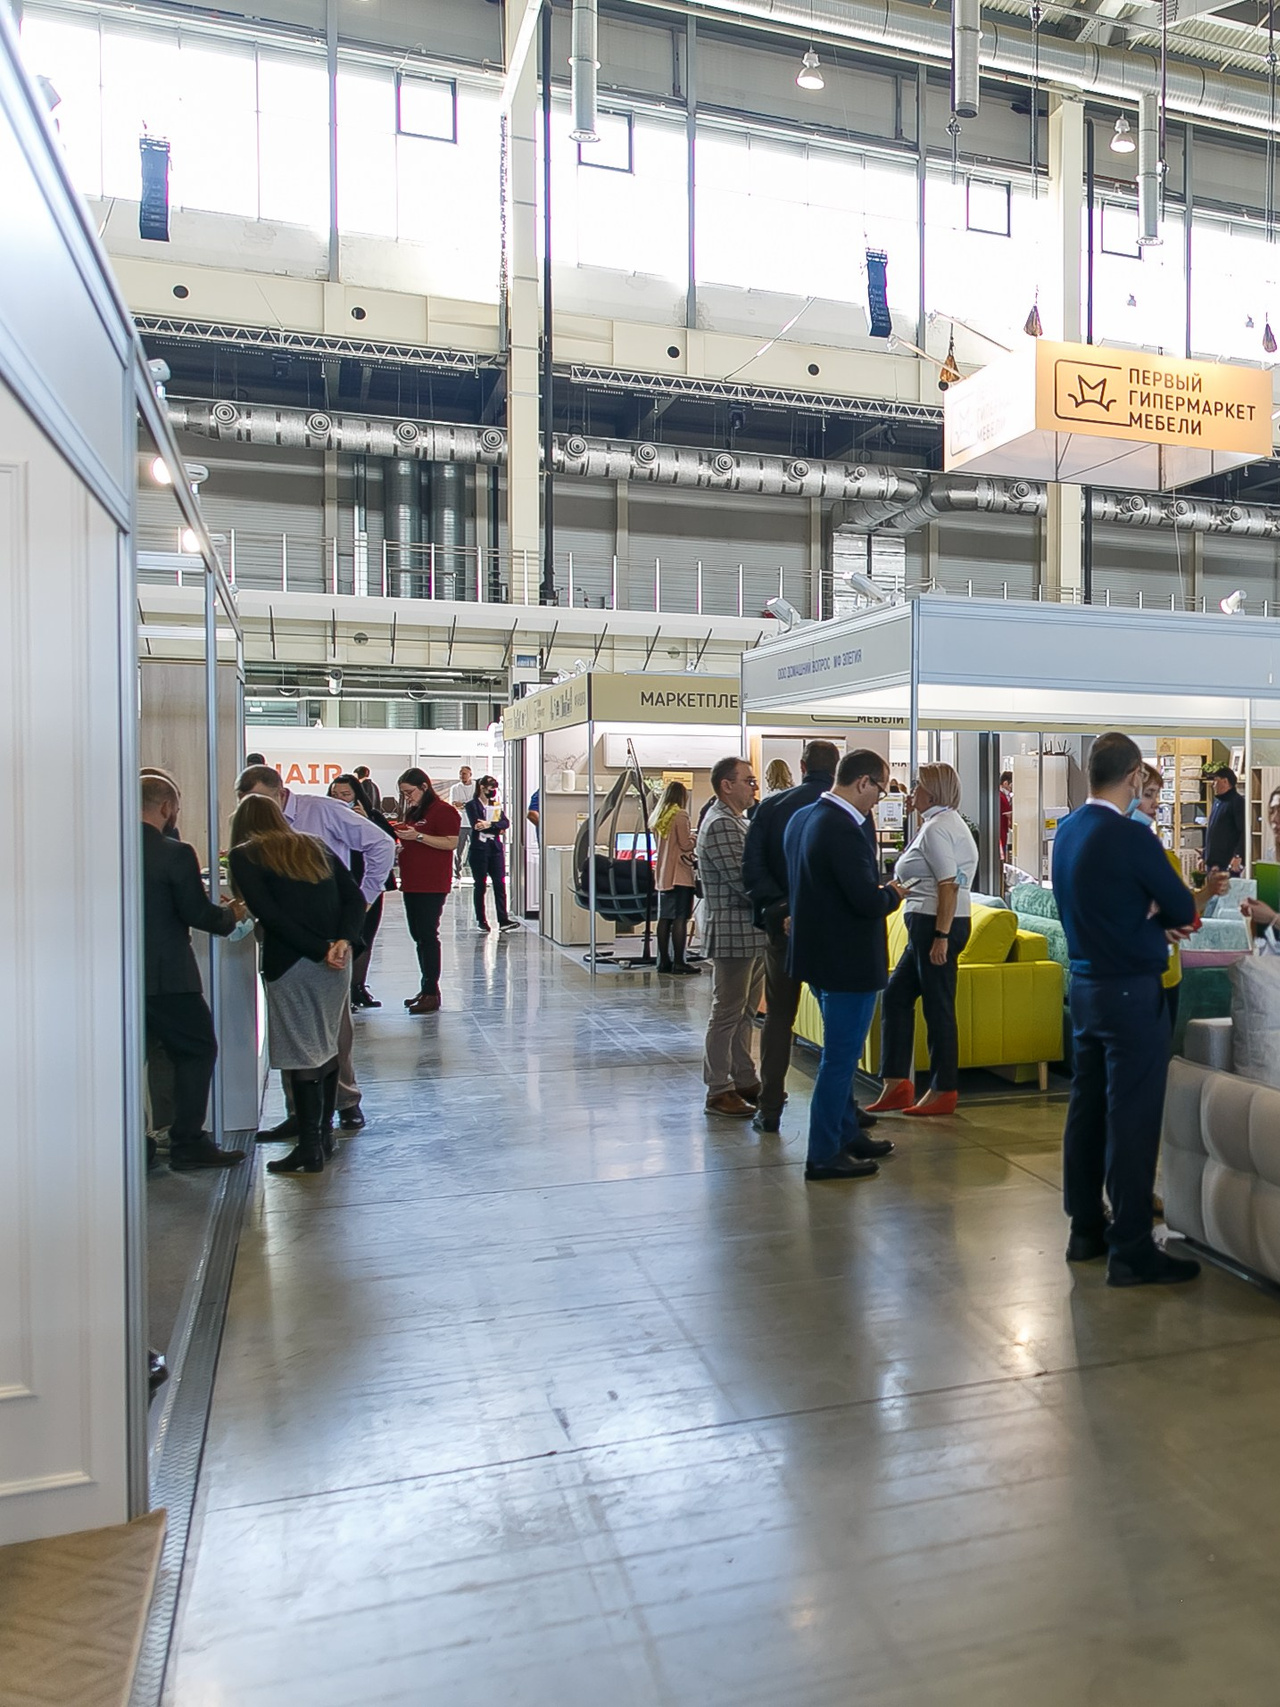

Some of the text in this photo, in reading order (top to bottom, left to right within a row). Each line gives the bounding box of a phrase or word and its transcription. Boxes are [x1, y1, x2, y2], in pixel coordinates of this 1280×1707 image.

[1129, 368, 1202, 393] ПЕРВЫЙ
[1129, 390, 1256, 421] ГИПЕРМАРКЕТ
[1129, 411, 1202, 436] МЕБЕЛИ
[641, 691, 739, 708] МАРКЕТПЛЕ
